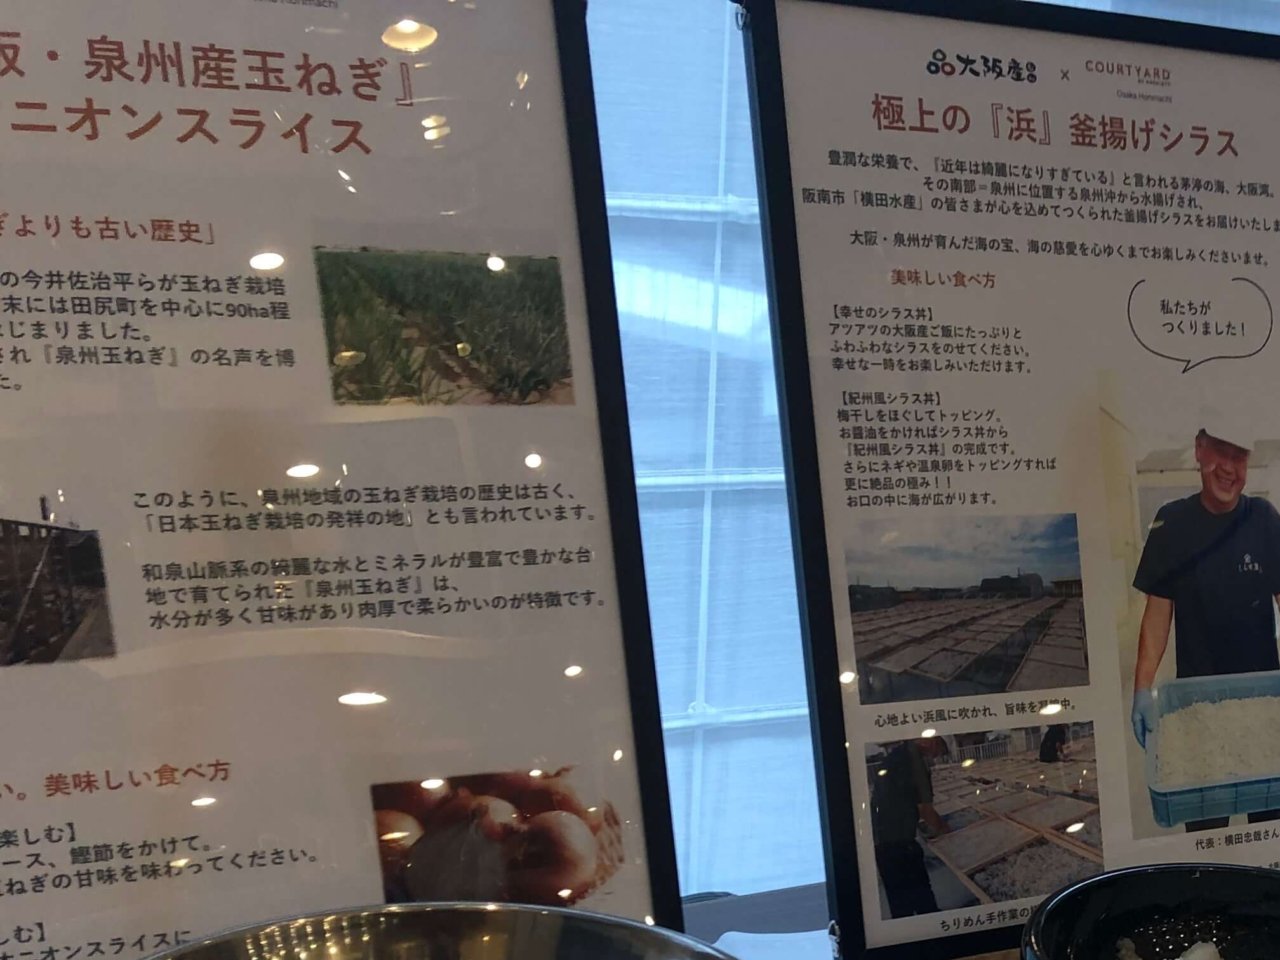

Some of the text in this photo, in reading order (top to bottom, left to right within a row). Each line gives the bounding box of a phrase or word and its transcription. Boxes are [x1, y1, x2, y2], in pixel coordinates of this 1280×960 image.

[1085, 59, 1171, 81] COURTYARD
[0, 212, 215, 245] よりも古い歴史」
[890, 269, 997, 290] 美味しい食べ方
[1159, 297, 1212, 317] 私たちが
[0, 320, 151, 342] じまりました。
[0, 343, 296, 368] れ『泉州玉ねぎ』の名声を博
[0, 848, 318, 897] ねぎの甘味を味わってください。
